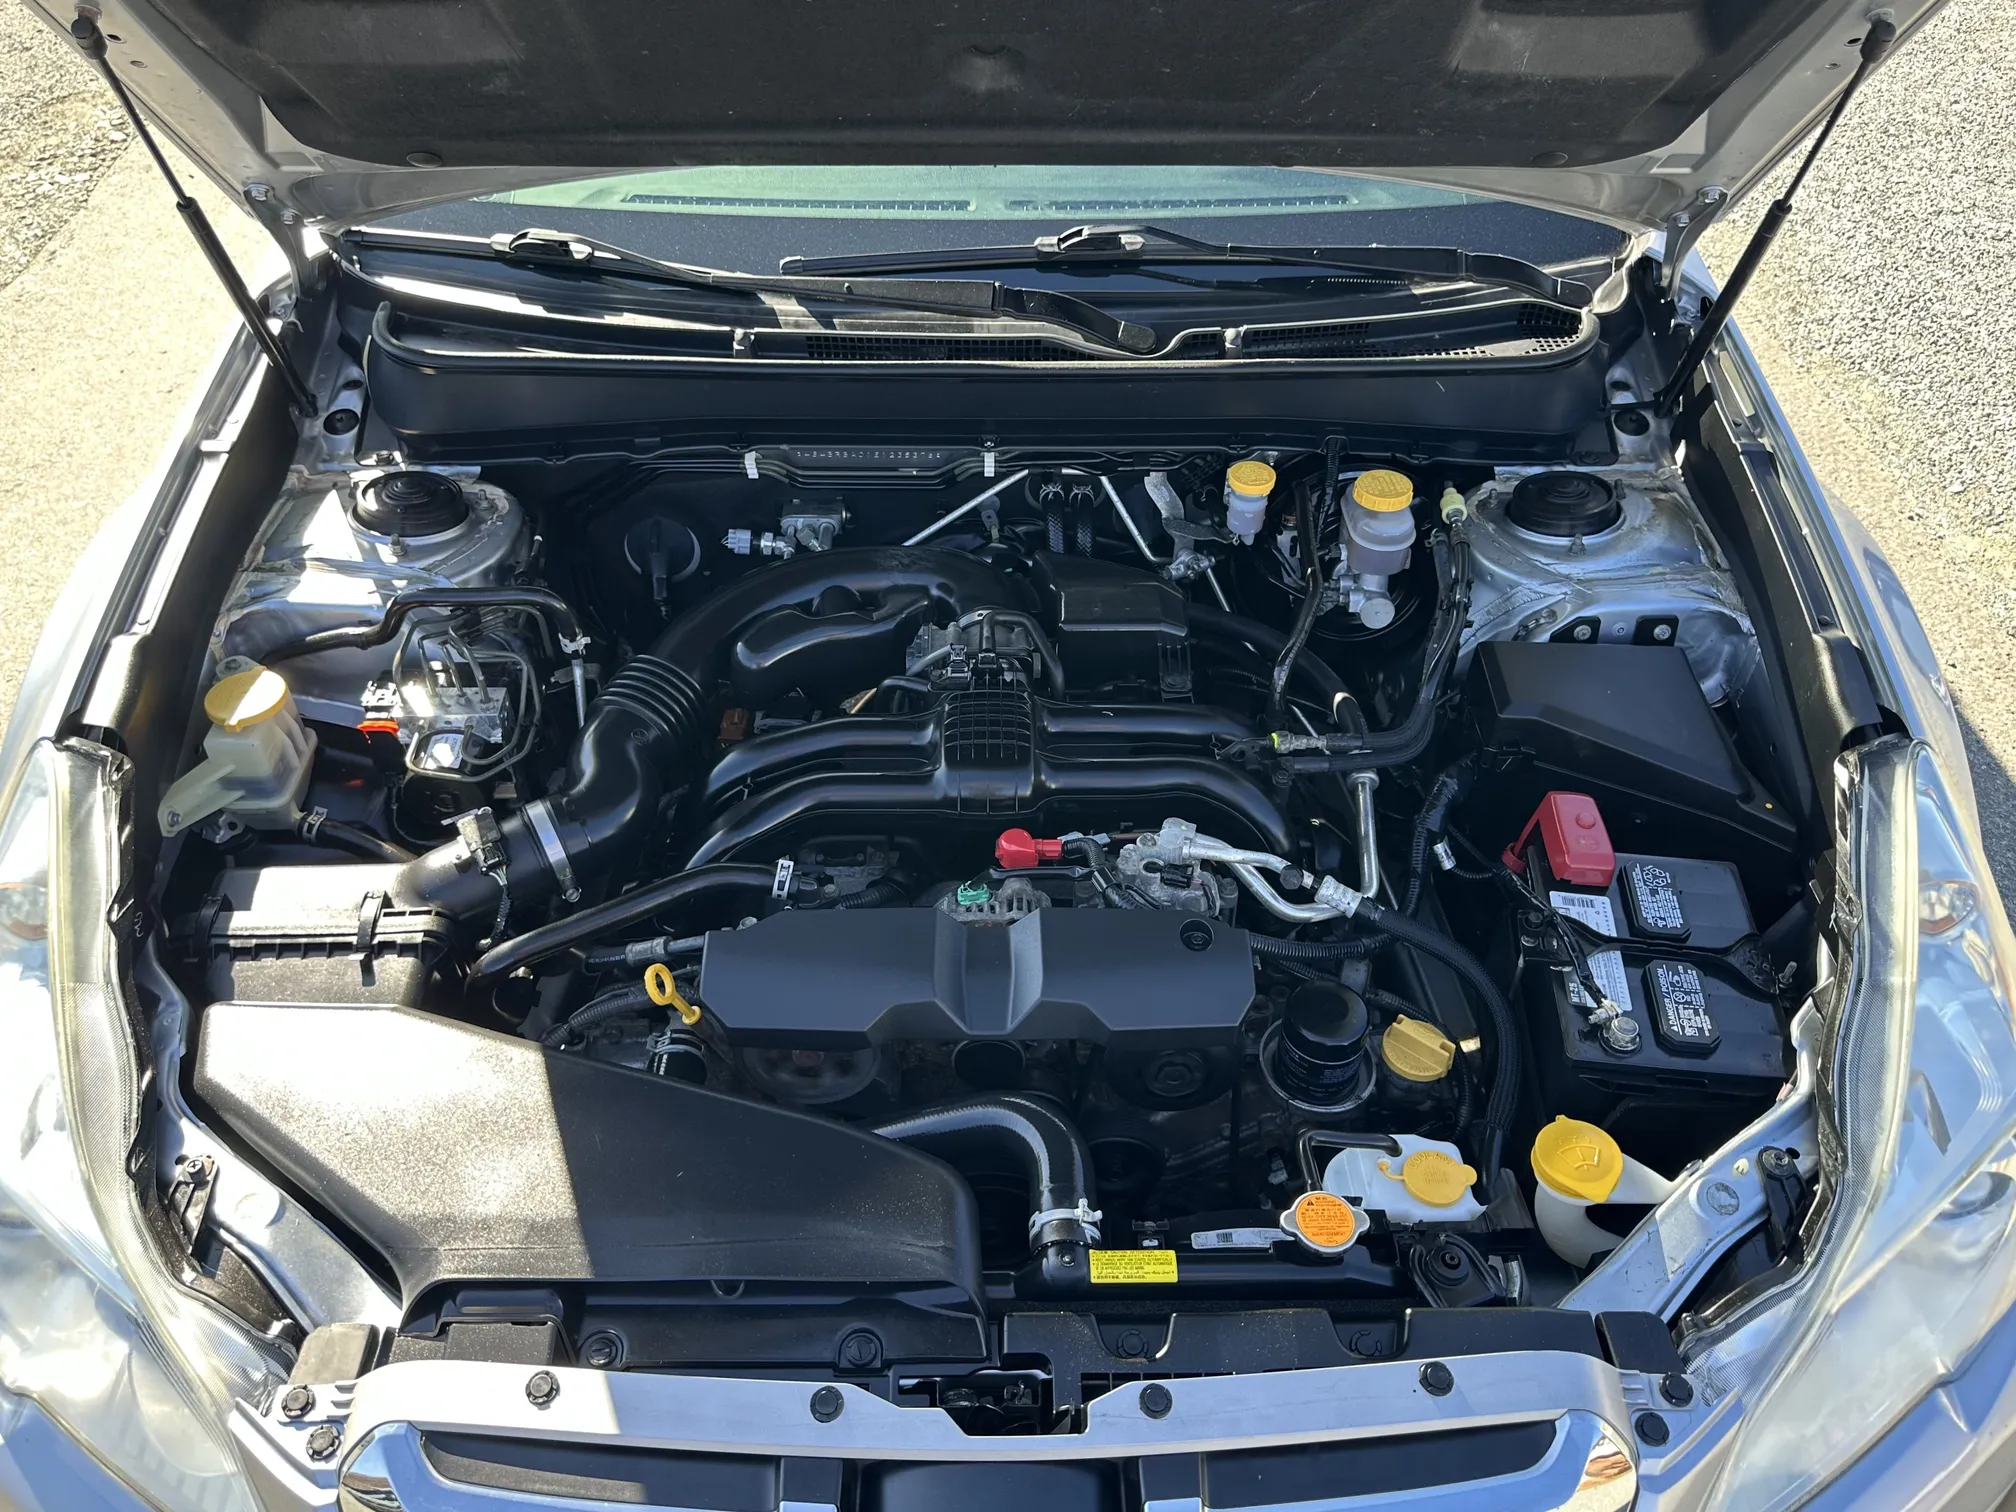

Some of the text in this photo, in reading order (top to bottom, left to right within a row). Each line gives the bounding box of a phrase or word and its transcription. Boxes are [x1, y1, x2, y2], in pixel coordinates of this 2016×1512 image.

[1656, 968, 1669, 992] POISON
[1664, 998, 1676, 1025] DANGER
[1407, 1151, 1456, 1169] COOLANT
